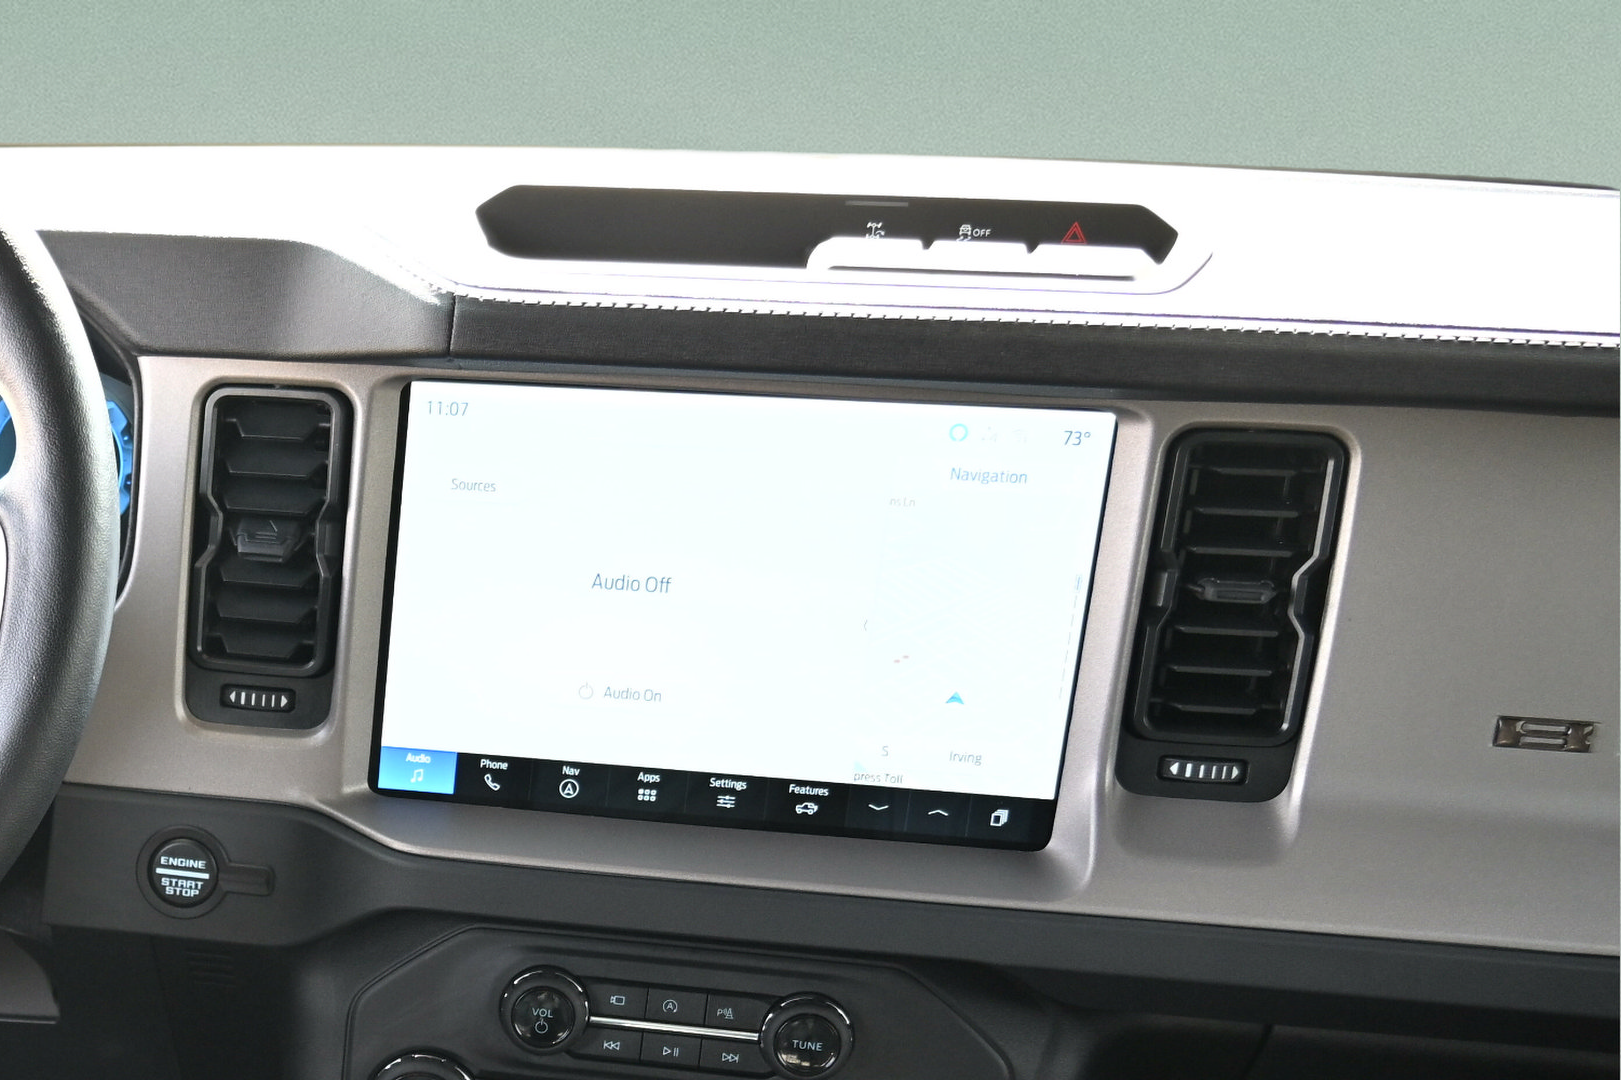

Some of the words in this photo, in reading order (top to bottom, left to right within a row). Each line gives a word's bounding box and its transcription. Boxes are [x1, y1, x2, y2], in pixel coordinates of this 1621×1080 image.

[972, 228, 992, 238] OFF
[425, 399, 469, 418] 11:07
[949, 465, 1029, 487] Navigation
[450, 477, 497, 495] Sources
[591, 573, 640, 594] Audio
[644, 573, 672, 595] Off
[604, 684, 639, 703] Audio
[641, 687, 662, 704] On
[405, 752, 432, 764] Audio
[479, 758, 509, 772] Phone
[948, 750, 983, 767] Irving
[561, 765, 580, 777] Nav
[636, 771, 661, 785] Apps
[709, 777, 748, 792] Settings
[788, 784, 830, 798] Features
[160, 856, 207, 869] ENGINE
[161, 877, 204, 890] START
[165, 887, 200, 897] STOP
[531, 1007, 554, 1018] VOL
[792, 1039, 823, 1052] TUNE
